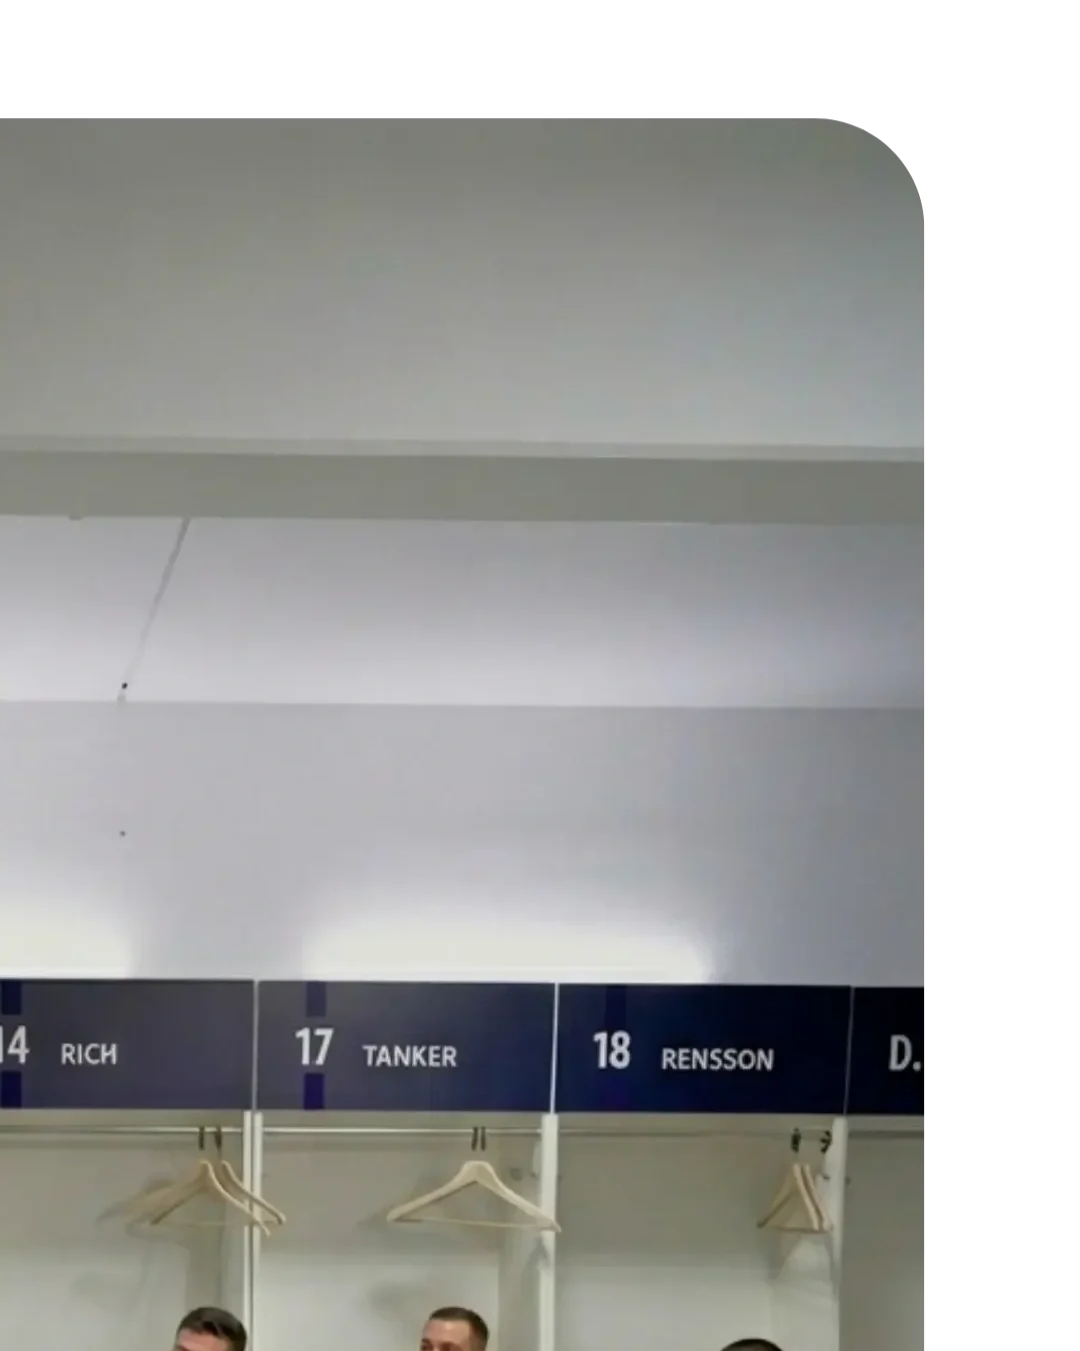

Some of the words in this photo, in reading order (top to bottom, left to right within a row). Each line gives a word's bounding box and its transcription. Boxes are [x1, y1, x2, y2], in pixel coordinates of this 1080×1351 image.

[61, 1043, 117, 1065] RICH
[295, 1026, 335, 1066] 17
[362, 1044, 457, 1068] TANKER
[593, 1030, 631, 1069] 18
[661, 1048, 774, 1072] RENSSON
[888, 1034, 922, 1072] D.
